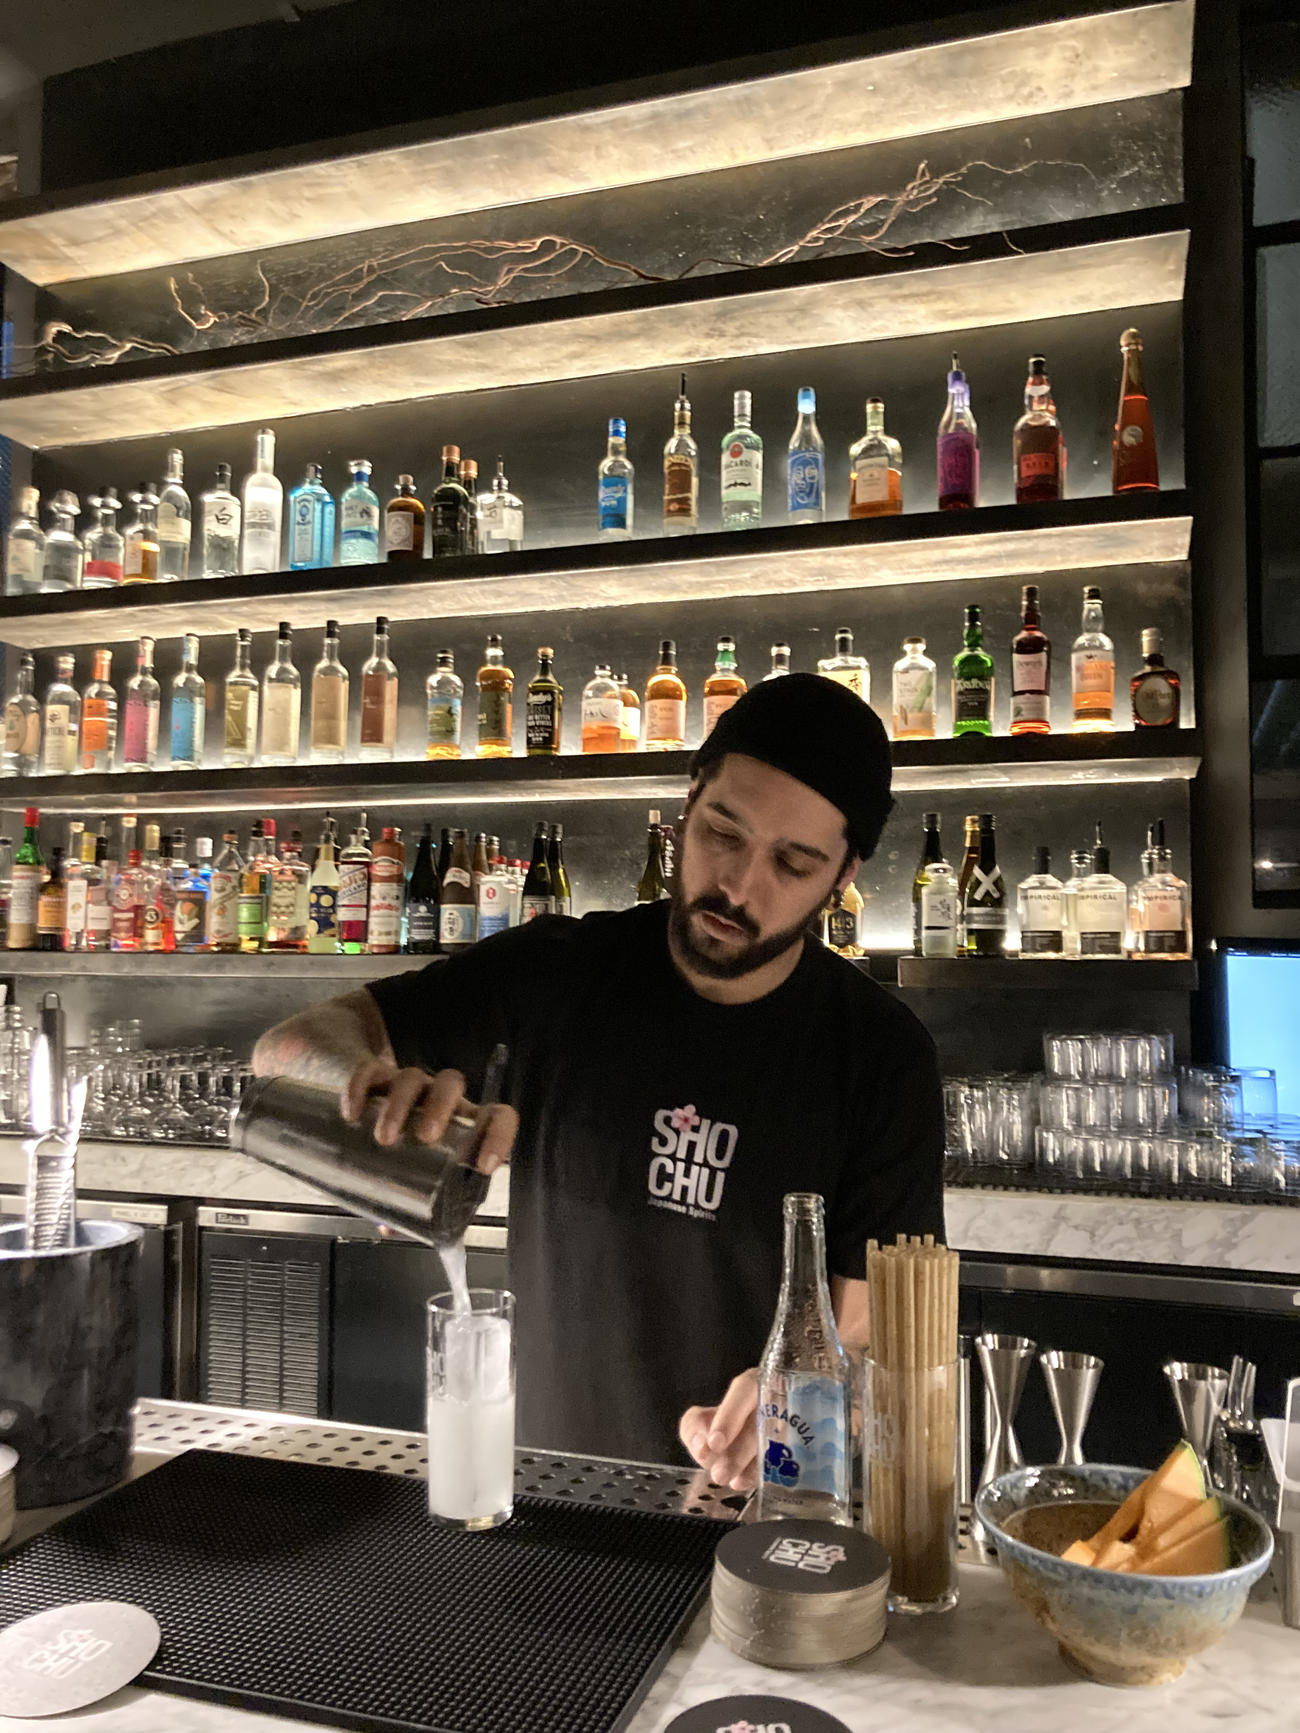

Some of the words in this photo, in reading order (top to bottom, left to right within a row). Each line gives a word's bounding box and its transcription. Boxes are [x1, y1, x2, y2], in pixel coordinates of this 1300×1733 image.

[651, 1108, 739, 1169] SHO
[648, 1156, 727, 1211] CHU
[769, 1538, 811, 1567] CHU
